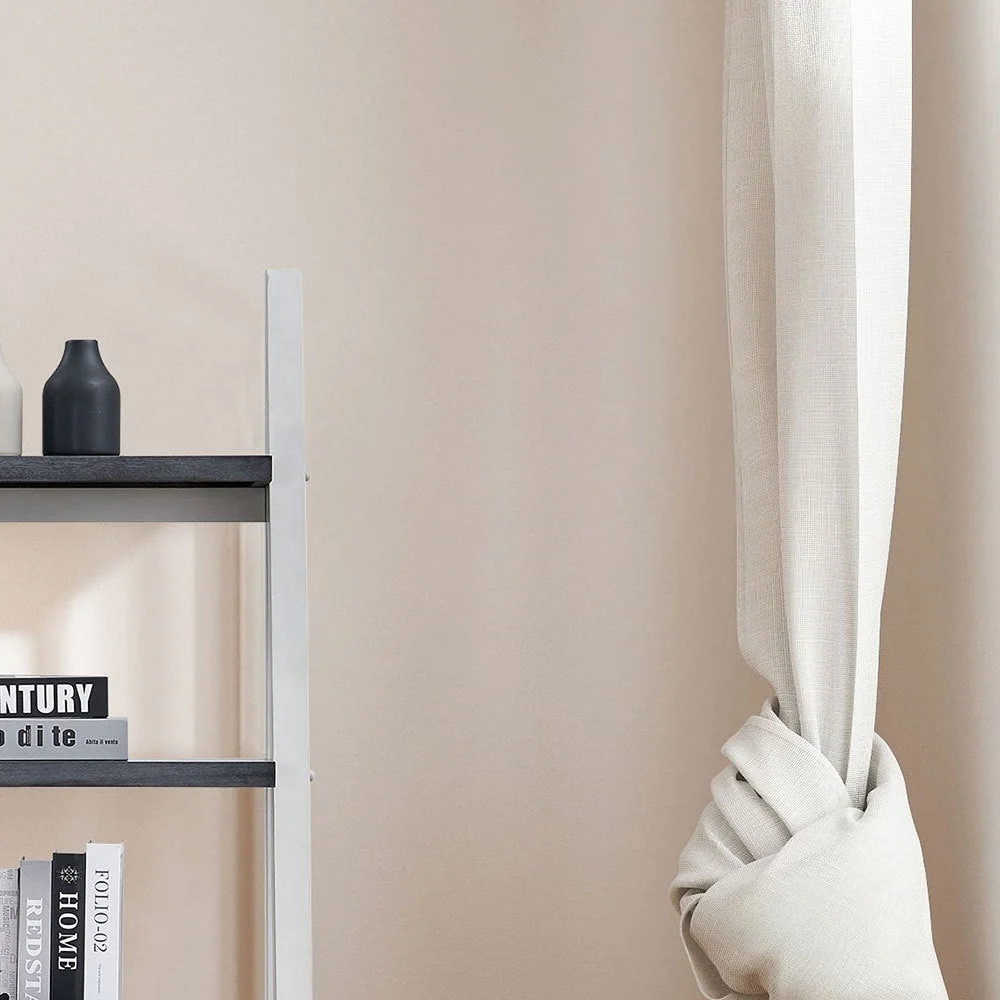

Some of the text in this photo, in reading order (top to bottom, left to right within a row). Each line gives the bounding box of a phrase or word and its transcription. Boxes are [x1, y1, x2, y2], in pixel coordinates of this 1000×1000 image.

[17, 725, 43, 747] di
[51, 725, 76, 747] te
[58, 892, 79, 971] HOME
[93, 869, 109, 953] FOLIO-02
